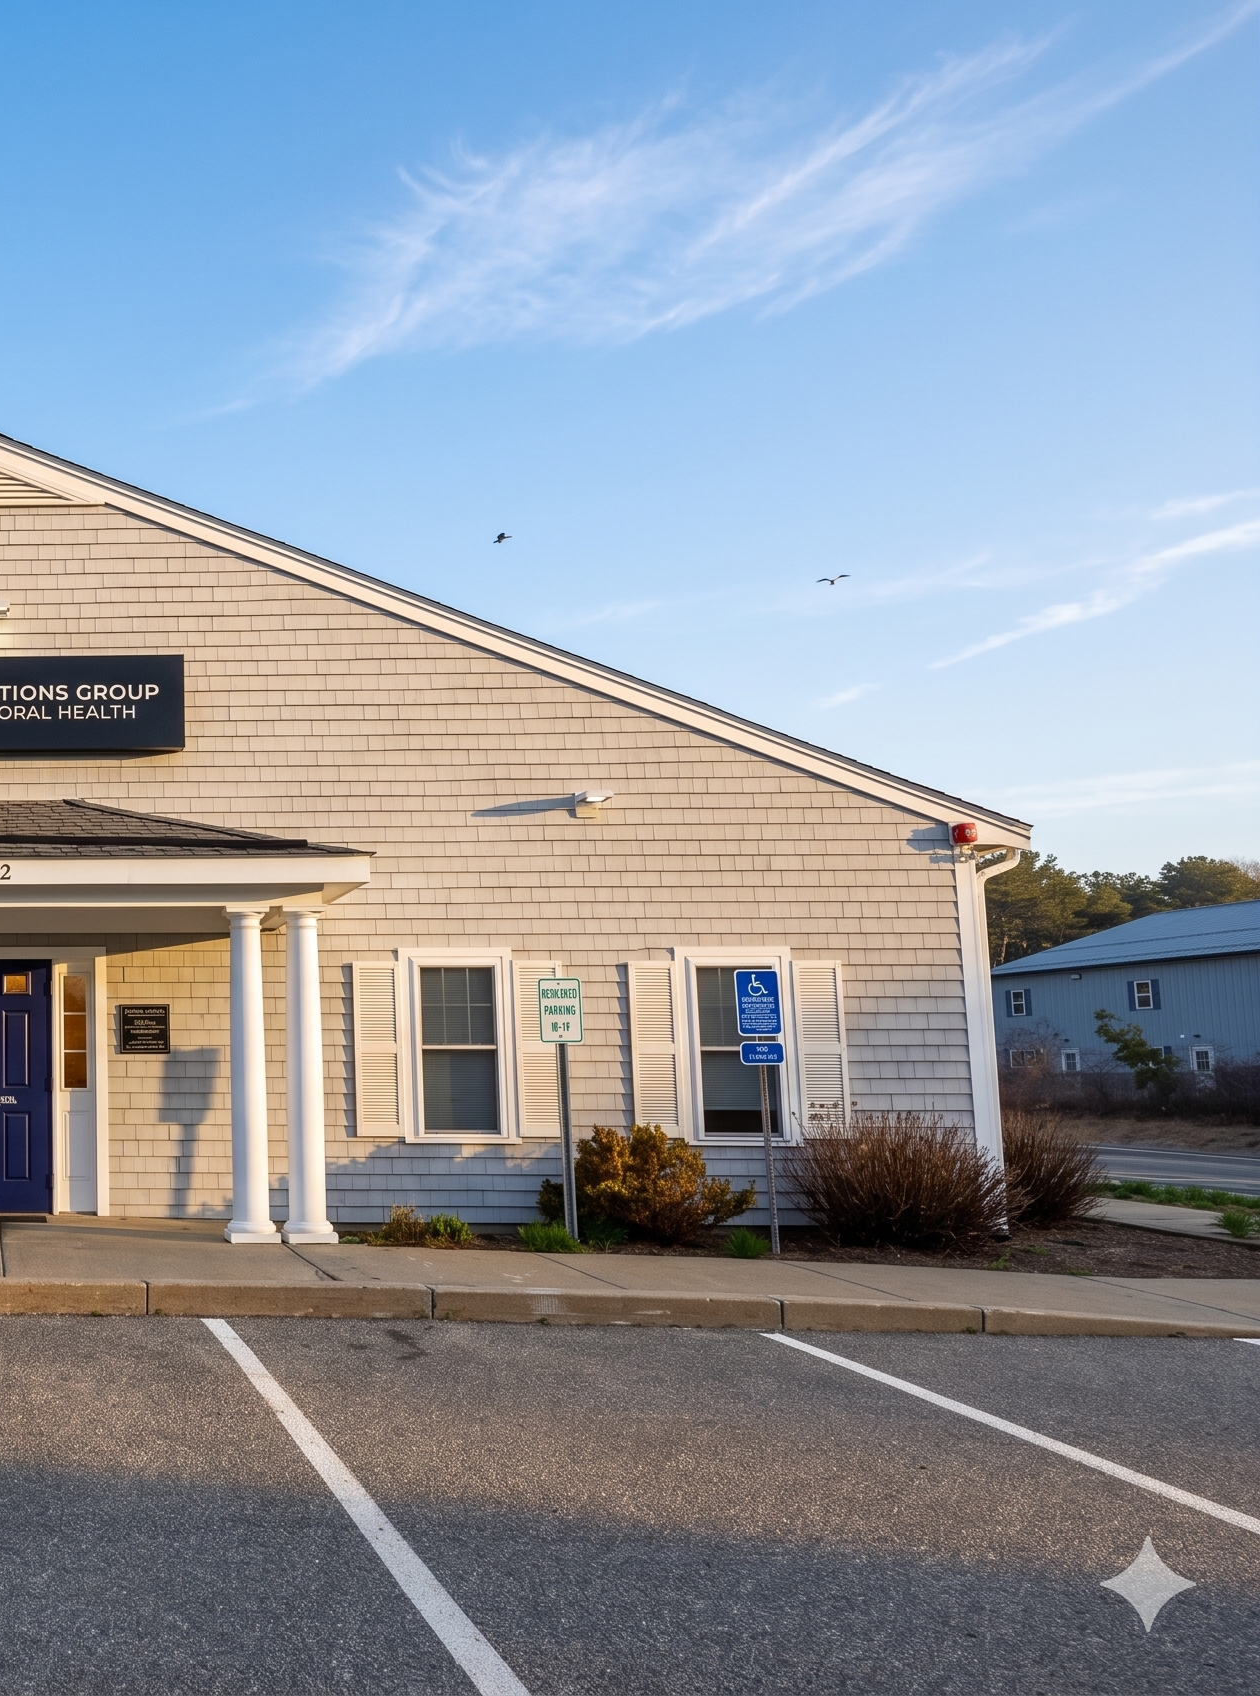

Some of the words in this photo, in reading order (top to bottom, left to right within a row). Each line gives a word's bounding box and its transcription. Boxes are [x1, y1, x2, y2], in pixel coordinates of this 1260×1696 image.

[76, 684, 160, 700] GROUP
[58, 704, 136, 720] HEALTH
[544, 1005, 576, 1016] PARKING
